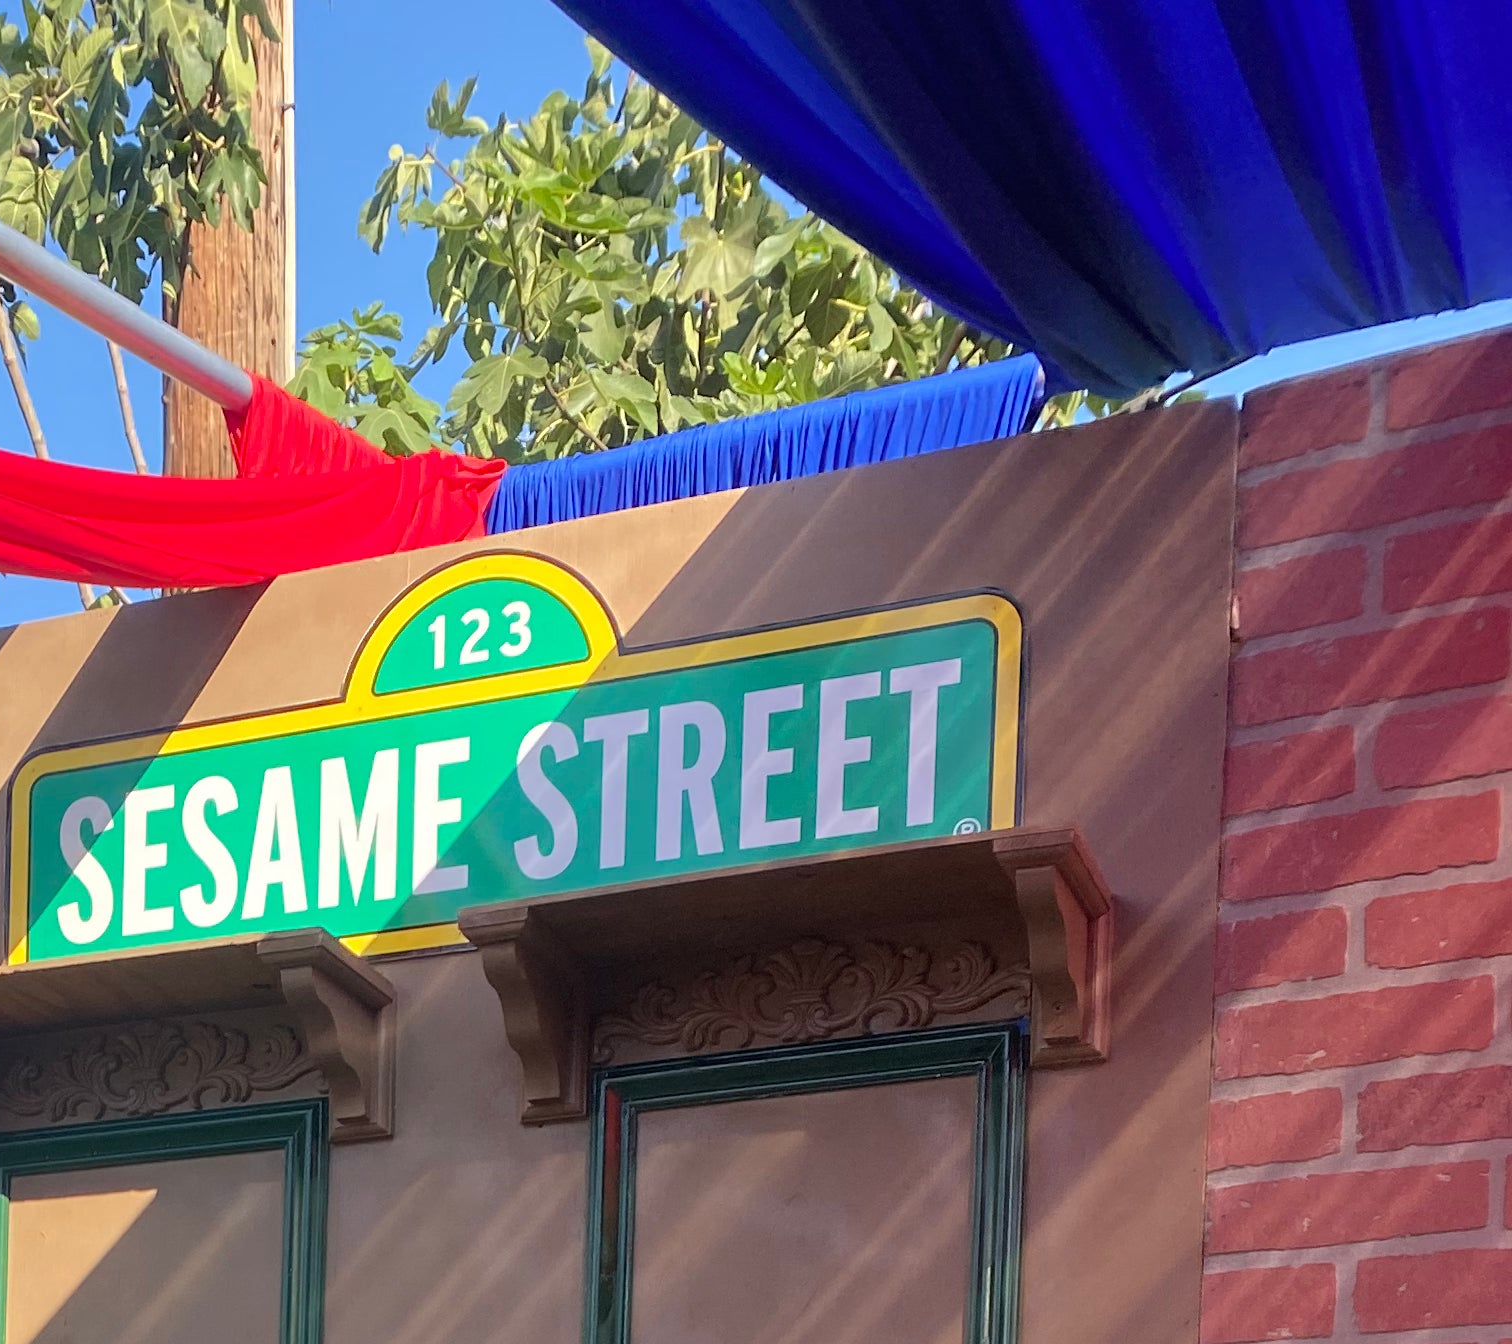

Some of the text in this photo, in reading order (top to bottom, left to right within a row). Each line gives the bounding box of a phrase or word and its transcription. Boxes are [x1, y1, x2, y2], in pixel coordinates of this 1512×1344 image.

[426, 600, 533, 670] 123
[56, 657, 963, 945] SESAME STREET
